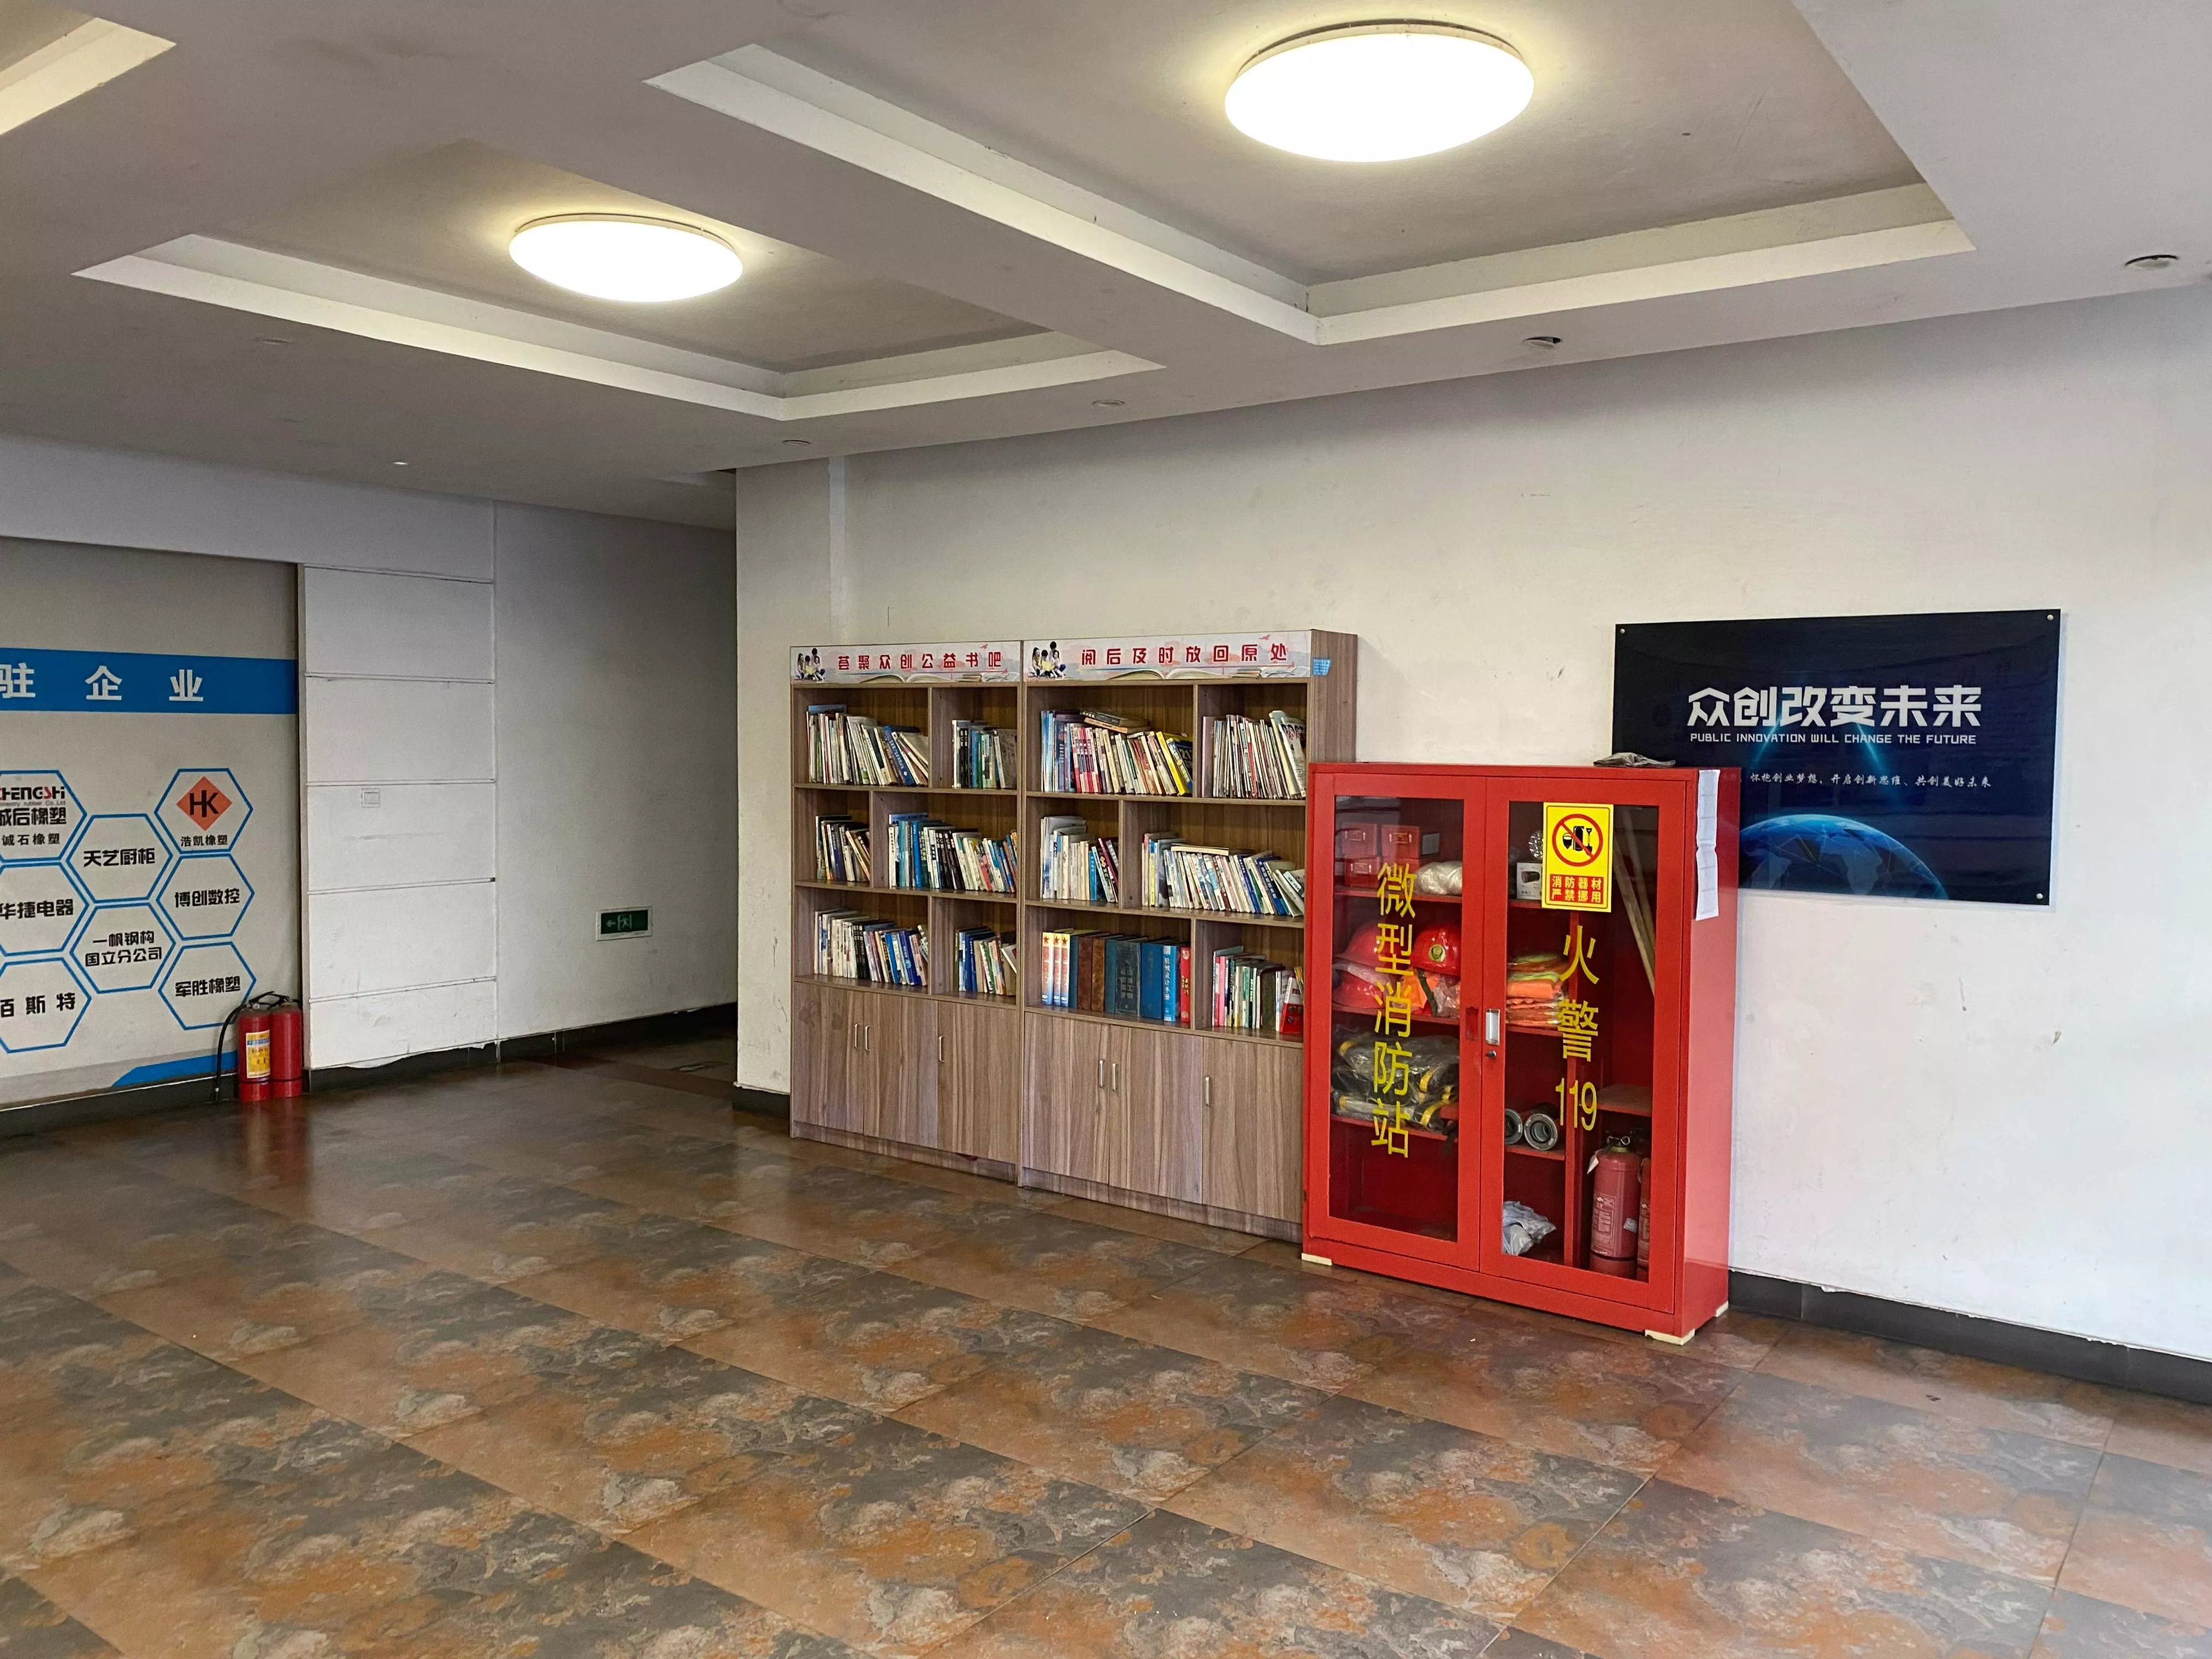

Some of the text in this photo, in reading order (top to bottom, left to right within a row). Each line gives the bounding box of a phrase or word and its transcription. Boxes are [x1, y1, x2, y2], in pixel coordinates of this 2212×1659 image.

[838, 651, 1002, 670] 荟聚众创公益书吧
[1081, 643, 1287, 665] 阅后及时放回原处
[1686, 685, 1982, 727] 众创改变未来
[1690, 733, 1976, 744] PUBLIC INNOVATION WILL CHANGE THE FUTURE
[190, 790, 219, 817] HK
[2, 833, 60, 846] 诚石橡塑
[180, 834, 228, 847] 浩凯橡塑
[83, 848, 155, 867] 天艺厨柜
[1552, 875, 1602, 890] 消防器材
[174, 888, 240, 908] 博创数控
[1551, 889, 1601, 904] 严禁挪用
[0, 899, 74, 919] 华捷电器
[93, 930, 154, 947] 一帆钢构
[85, 946, 162, 967] 国立分公司
[175, 976, 240, 997] 军胜橡塑
[1371, 862, 1417, 1158] 微型消防站
[1555, 924, 1600, 1131] 火警 119
